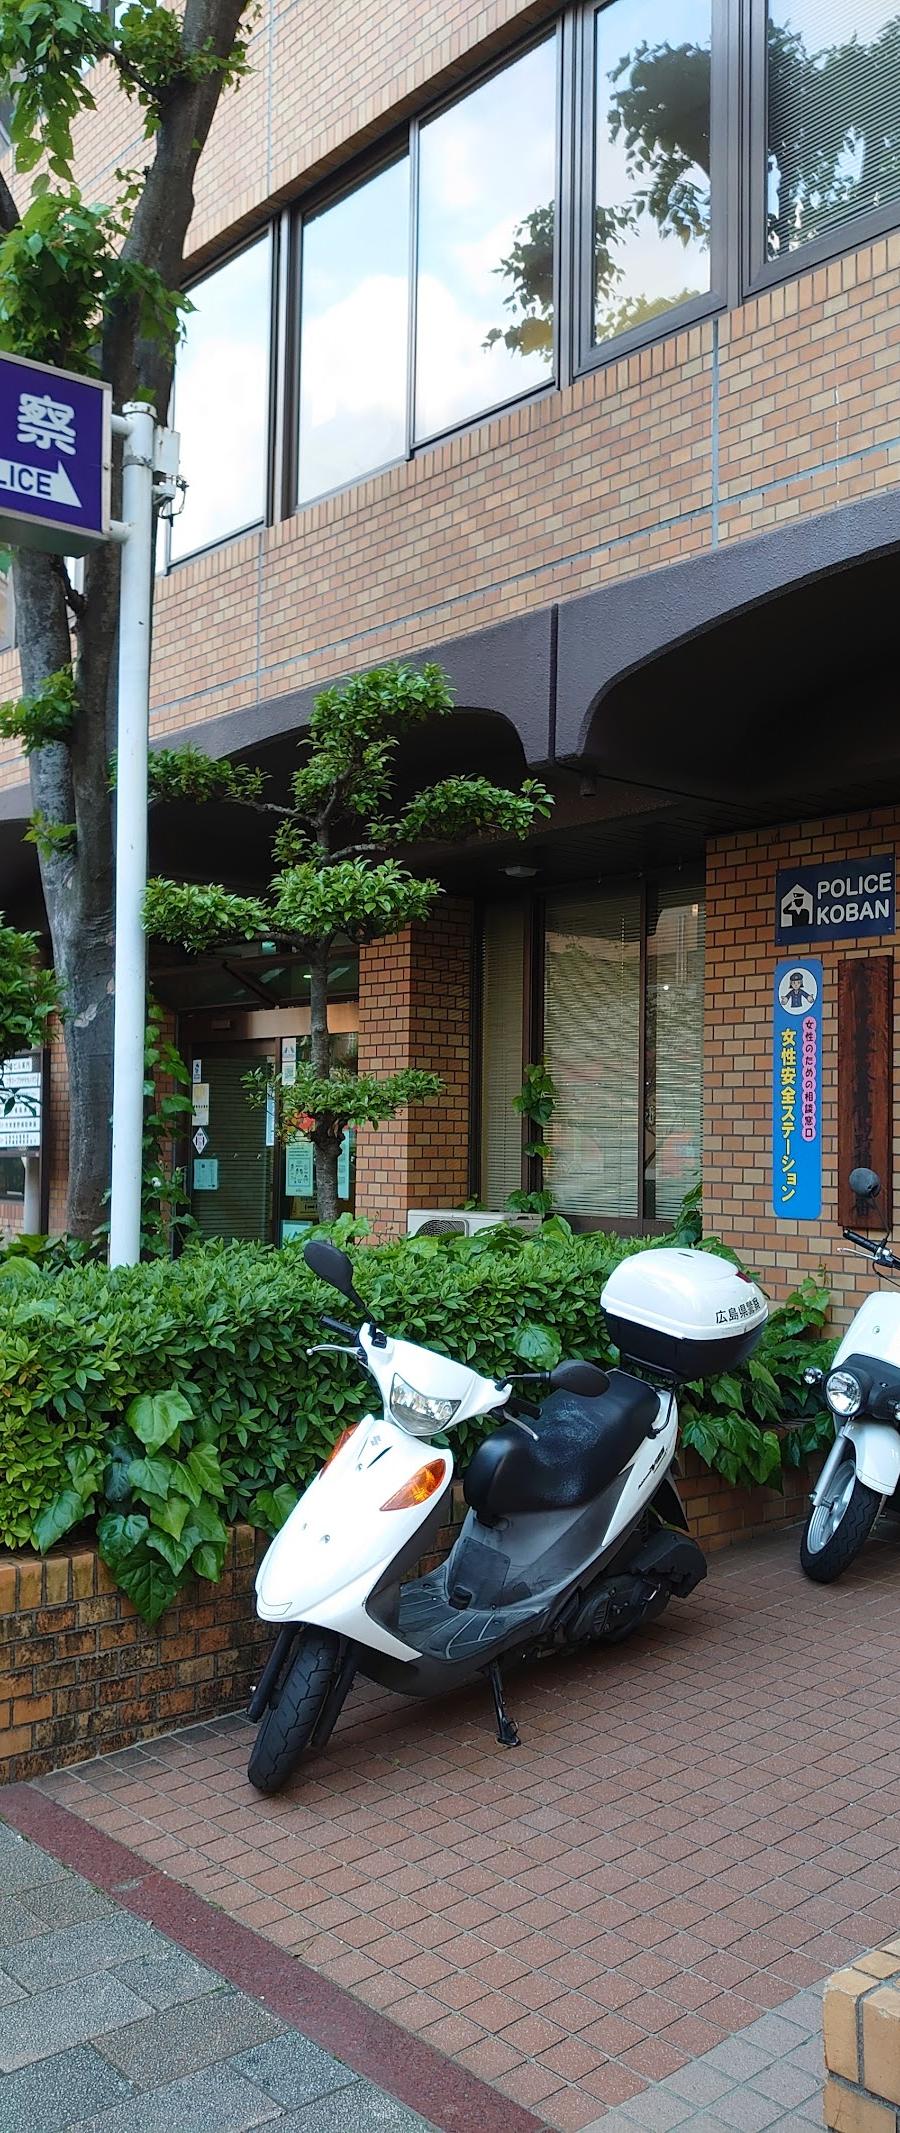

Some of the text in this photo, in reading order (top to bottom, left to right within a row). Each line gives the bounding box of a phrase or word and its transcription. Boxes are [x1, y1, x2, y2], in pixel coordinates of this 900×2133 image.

[17, 393, 77, 456] 察
[817, 872, 892, 900] POLICE
[816, 898, 890, 926] KOBAN
[804, 1019, 814, 1138] 女性のための相談窓口
[780, 1027, 797, 1202] 女性安全ステーション
[715, 1296, 761, 1324] 広島県警察
